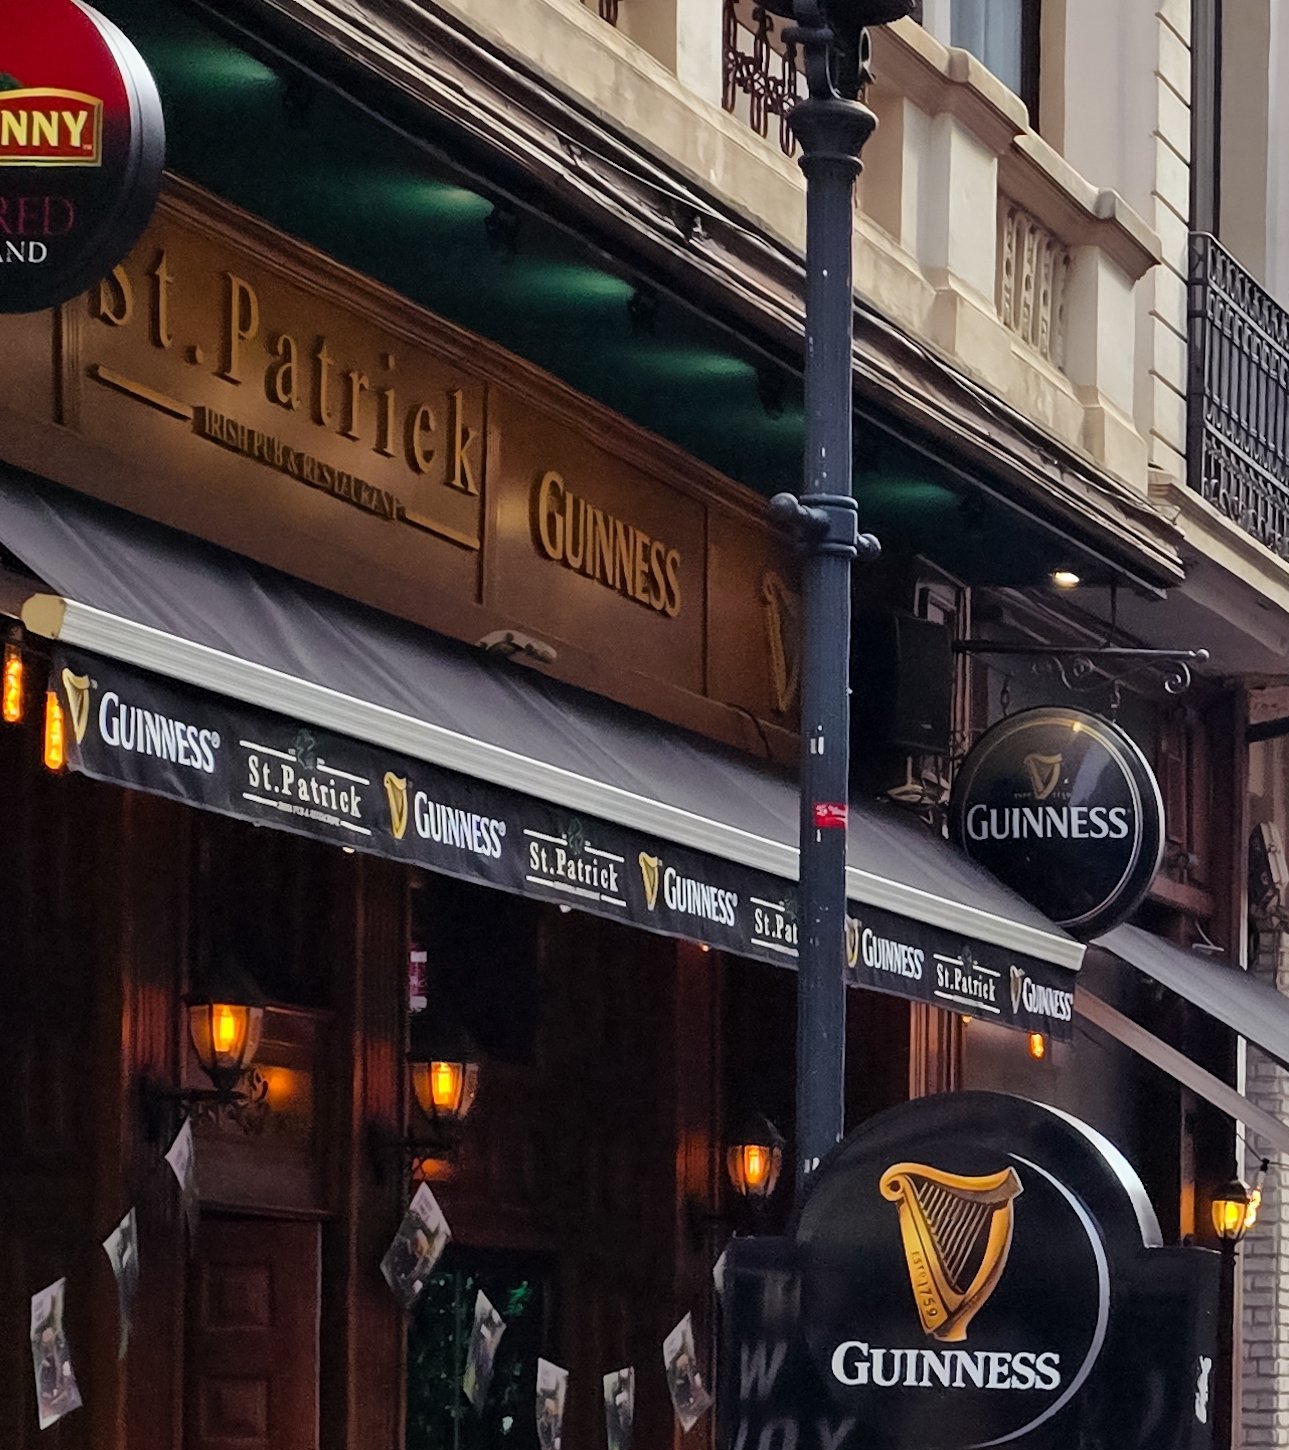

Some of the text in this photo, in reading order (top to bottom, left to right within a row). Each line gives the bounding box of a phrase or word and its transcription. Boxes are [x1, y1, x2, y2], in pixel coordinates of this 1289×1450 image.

[538, 470, 681, 618] GUINNESS
[99, 691, 215, 774] GUINNESS
[414, 791, 502, 859] GUINNESS
[966, 804, 1129, 841] GUINNESS
[663, 866, 735, 927] GUINNESS
[754, 907, 799, 945] St.Pat
[831, 1341, 1061, 1391] GUINNESS
